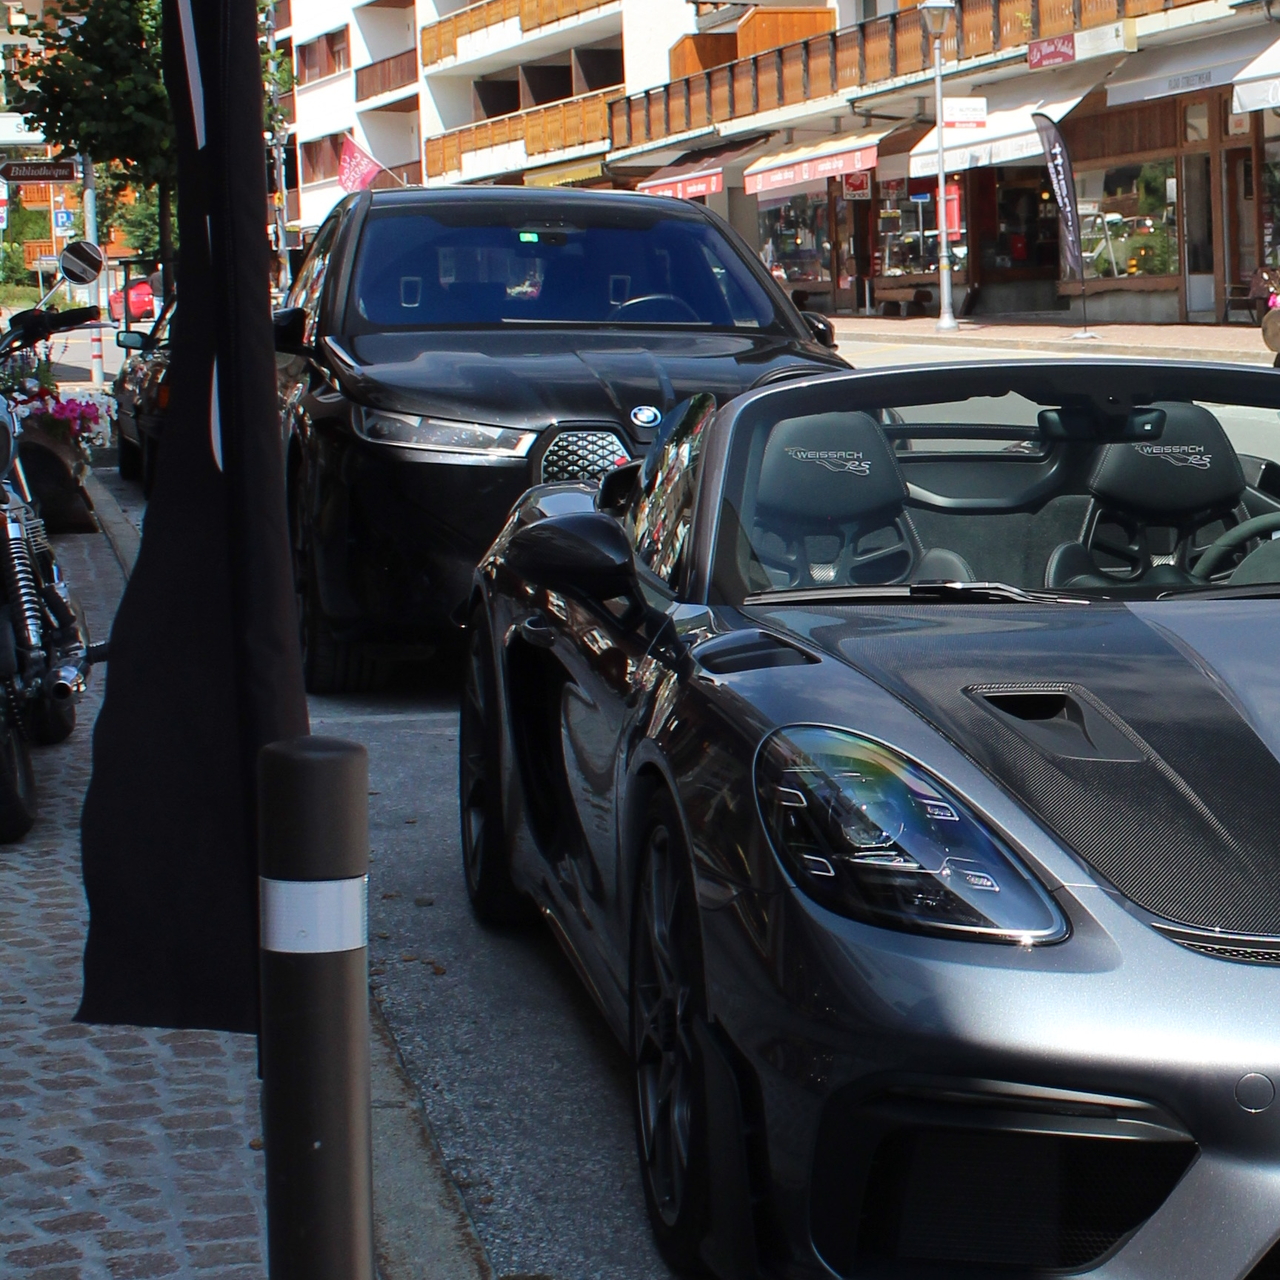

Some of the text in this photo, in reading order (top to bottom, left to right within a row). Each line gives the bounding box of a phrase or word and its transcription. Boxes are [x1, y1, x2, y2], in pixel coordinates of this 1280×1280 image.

[10, 166, 70, 179] Bibliothèque
[57, 212, 67, 227] P
[1142, 445, 1204, 453] WEISSACH
[796, 451, 863, 459] WEISSACH
